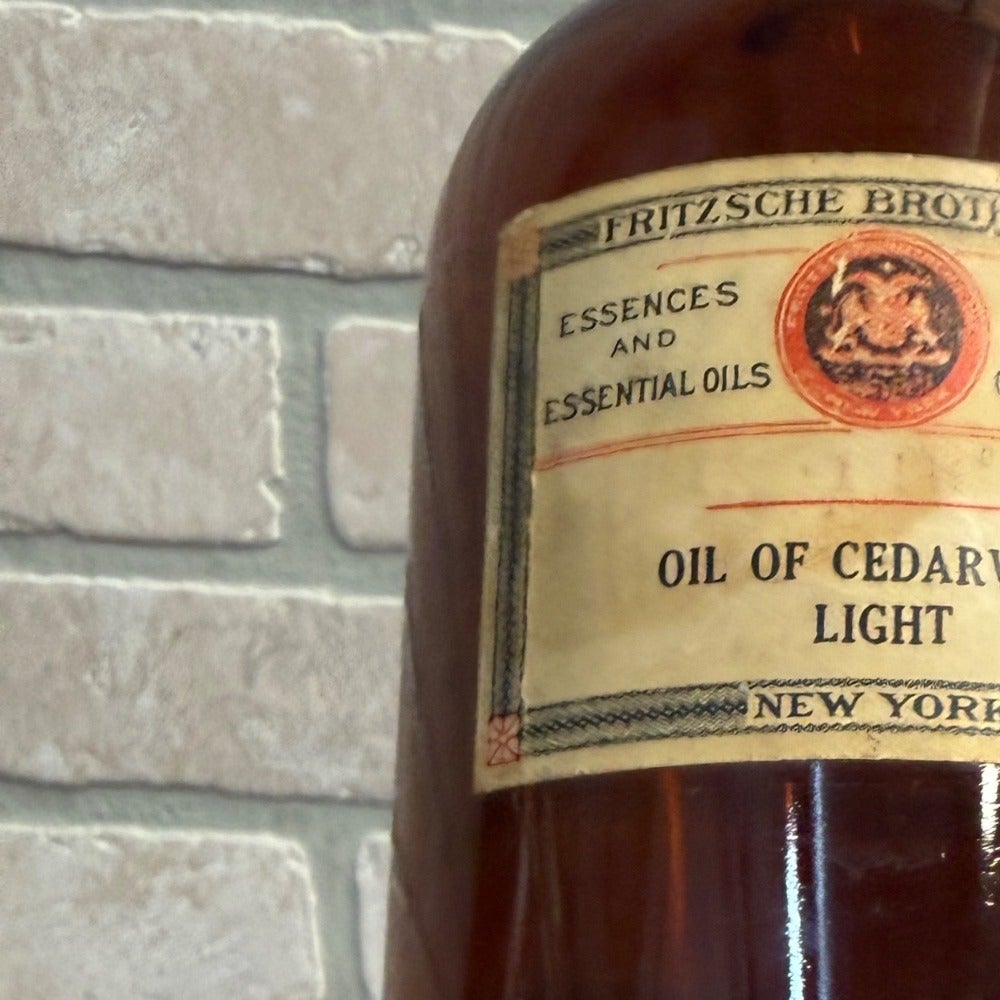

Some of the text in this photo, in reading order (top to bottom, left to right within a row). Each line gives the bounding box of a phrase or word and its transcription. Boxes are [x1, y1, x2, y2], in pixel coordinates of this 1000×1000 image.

[604, 187, 844, 244] FRITZSCHE
[558, 281, 740, 338] ESSENCES
[610, 328, 676, 358] AND
[543, 362, 773, 426] ESSENTIAL OILS
[657, 547, 727, 588] OIL
[750, 542, 809, 581] OF
[813, 603, 954, 645] LIGHT
[754, 691, 864, 719] NEW
